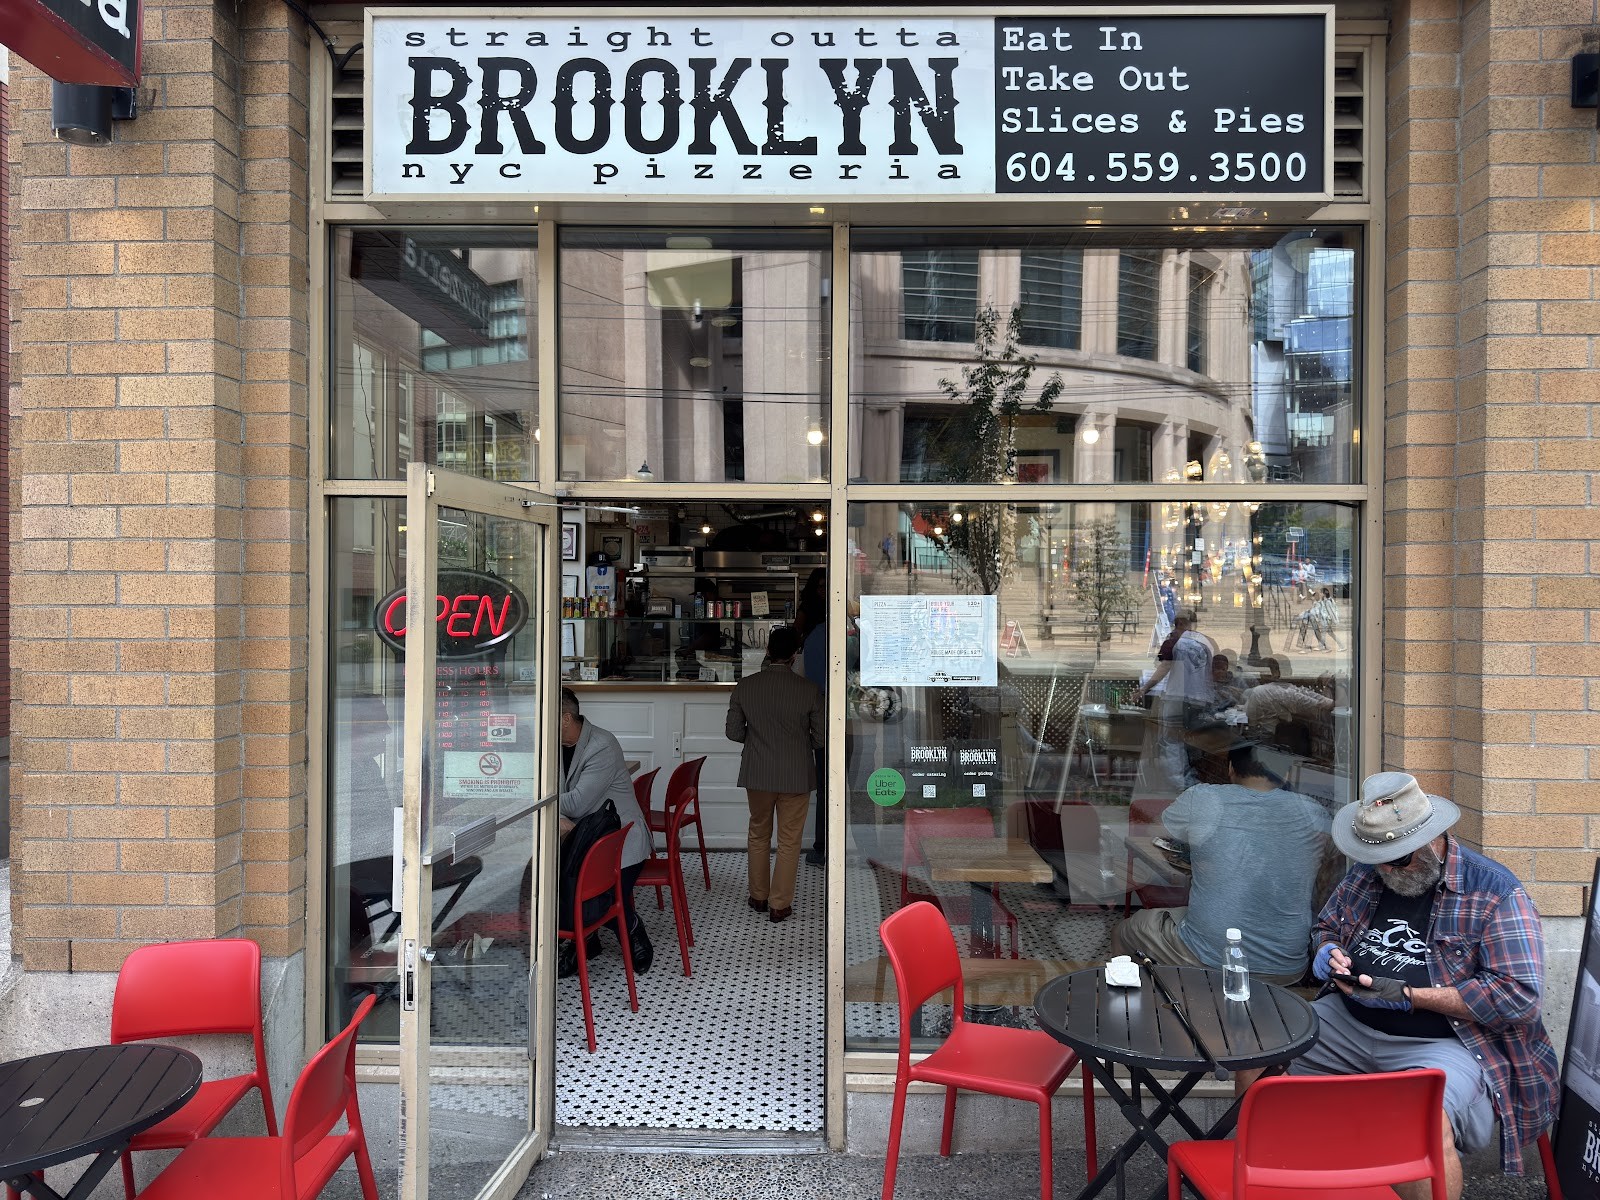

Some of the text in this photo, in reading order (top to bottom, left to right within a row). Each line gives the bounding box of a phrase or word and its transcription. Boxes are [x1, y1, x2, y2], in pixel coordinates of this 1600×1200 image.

[405, 27, 960, 53] straight outta
[1002, 27, 1143, 51] Eat In
[1002, 66, 1189, 91] Take Out
[405, 57, 964, 155] BROOKLYN
[1002, 107, 1305, 133] Slices & Pies
[402, 158, 961, 184] nyc pizzeria
[1006, 152, 1307, 182] 604.559.3500
[459, 665, 499, 675] HOURS
[911, 749, 947, 759] BROOKLYN
[960, 752, 996, 761] BROOKLYN
